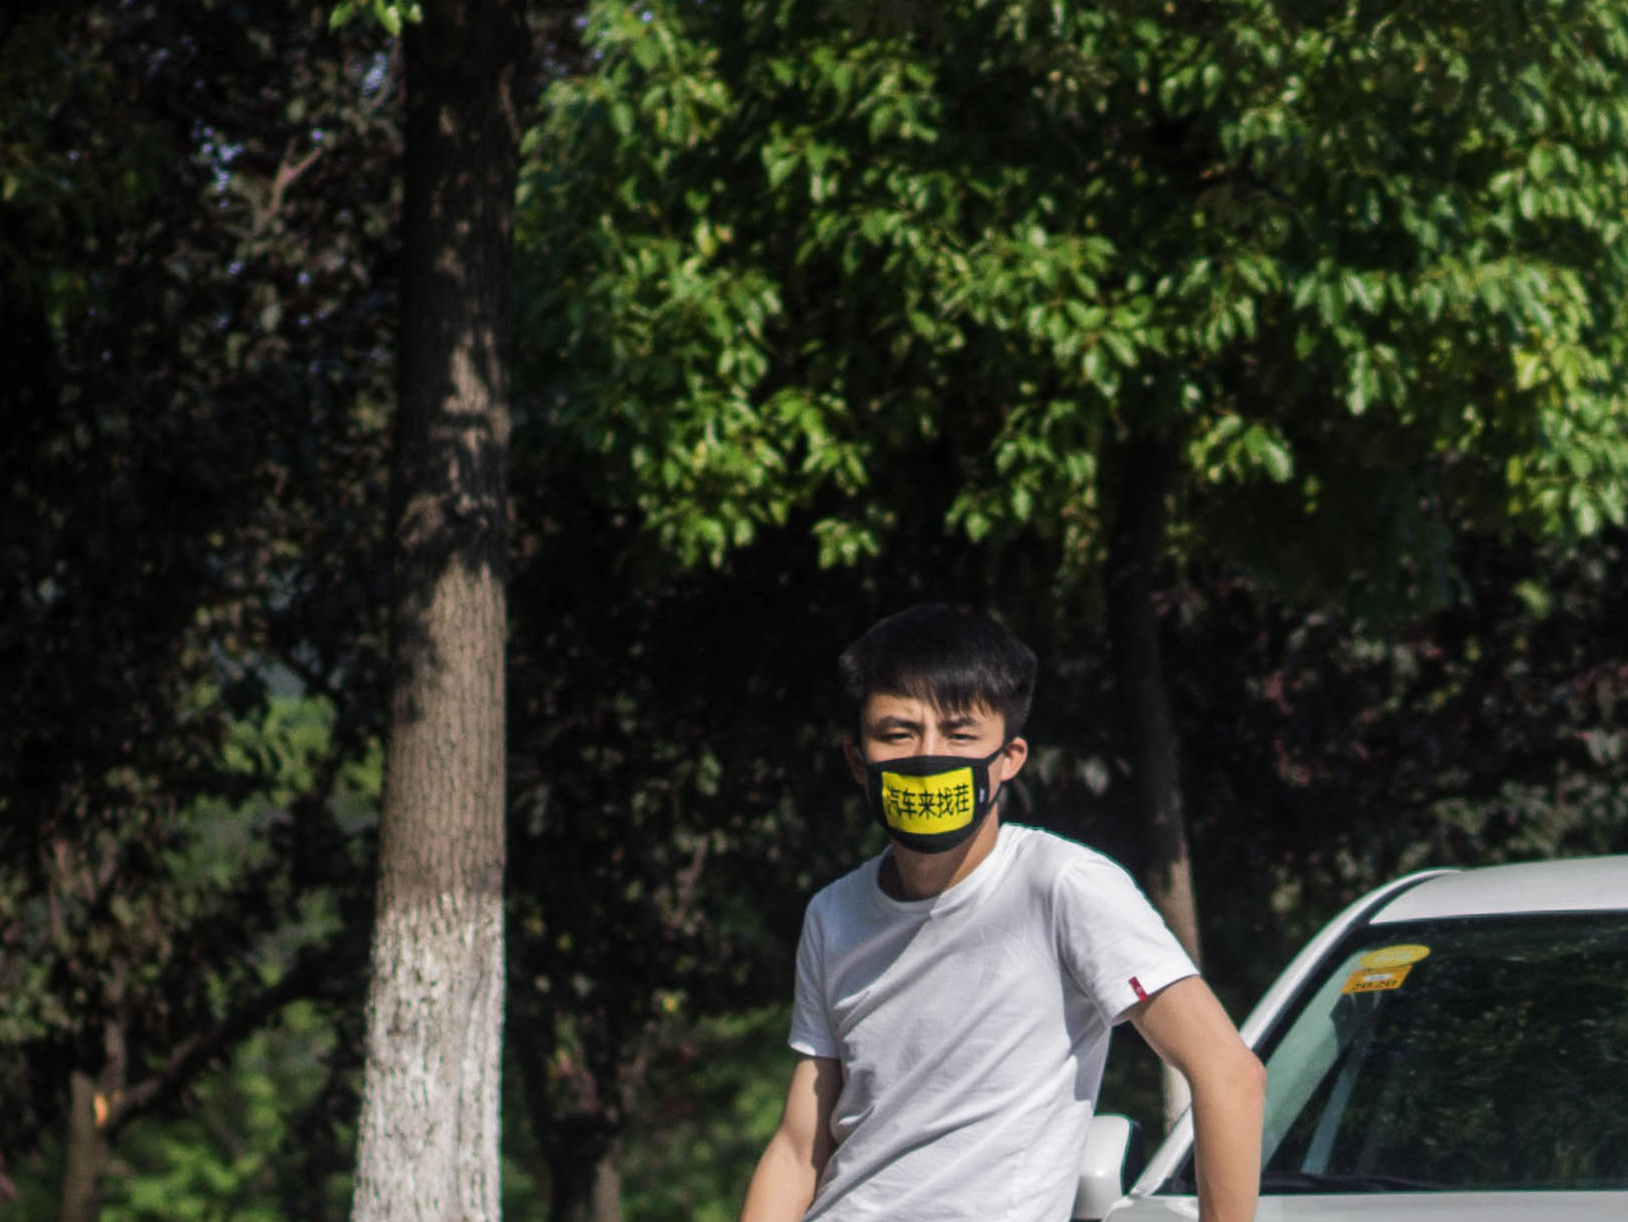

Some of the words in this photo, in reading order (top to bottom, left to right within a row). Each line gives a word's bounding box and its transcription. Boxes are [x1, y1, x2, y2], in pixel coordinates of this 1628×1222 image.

[887, 783, 970, 820] 汽车来找茬
